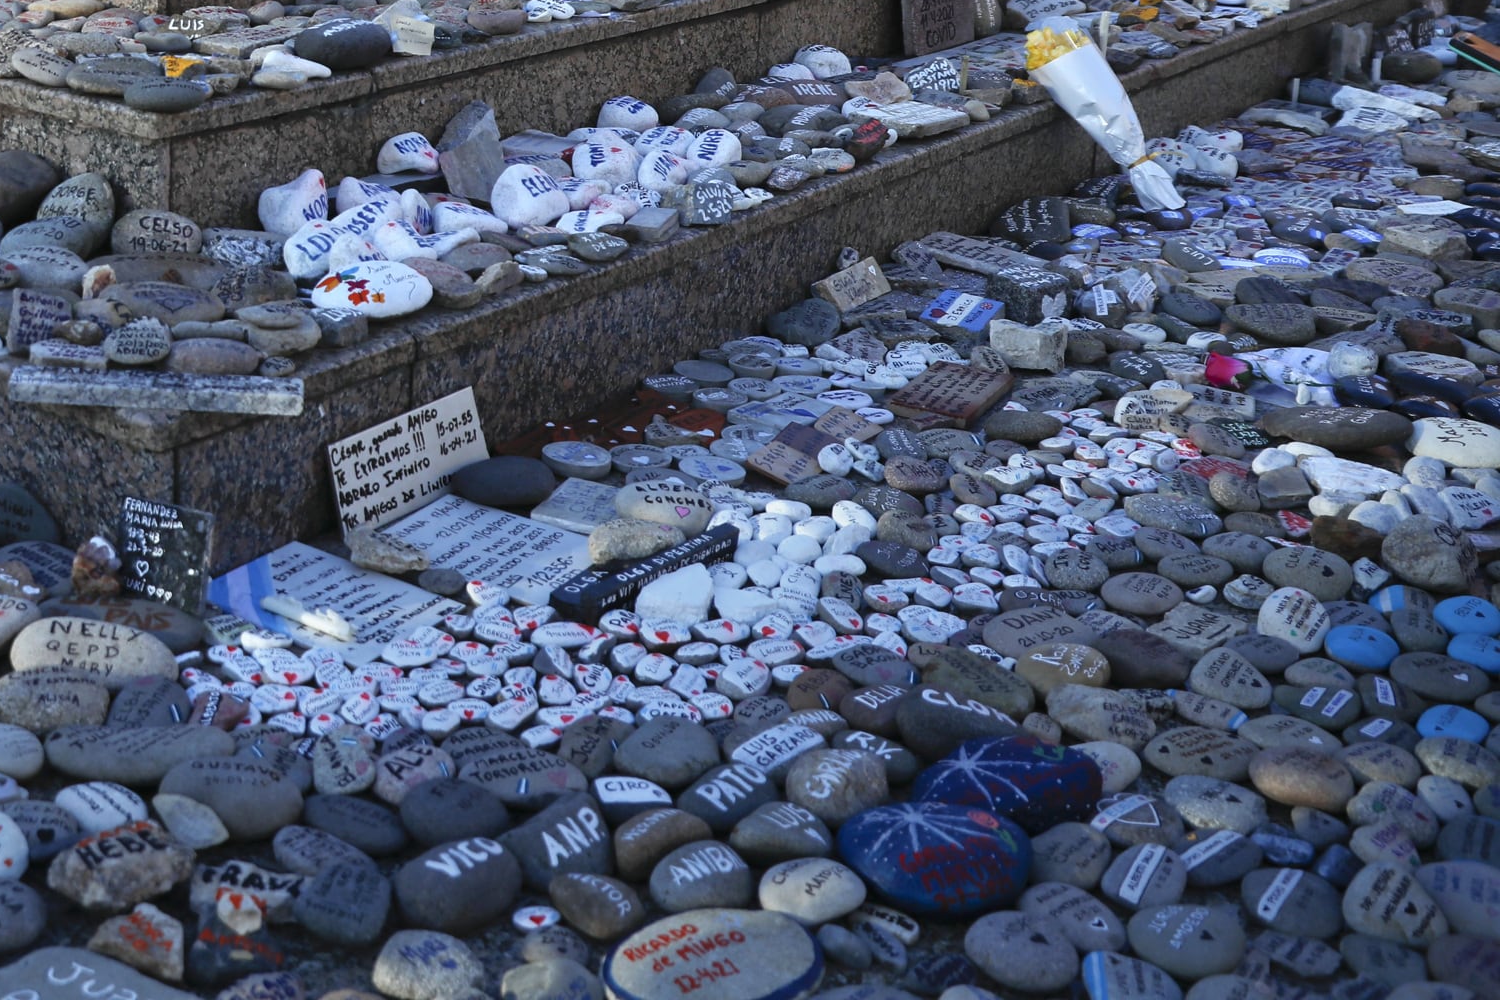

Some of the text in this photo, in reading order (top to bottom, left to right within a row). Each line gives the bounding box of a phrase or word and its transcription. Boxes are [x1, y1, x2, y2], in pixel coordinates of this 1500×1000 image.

[169, 18, 204, 31] LUIS
[926, 21, 956, 48] COVID
[792, 83, 837, 96] IRENE
[698, 129, 724, 161] NORA
[52, 187, 95, 199] JORGE
[696, 185, 732, 201] SILVIA
[139, 216, 193, 237] CELSO
[130, 237, 188, 251] 19-06-21
[1265, 256, 1302, 265] POCHA
[436, 409, 473, 438] 15-07-55
[335, 468, 347, 489] TE
[339, 481, 380, 508] ABRAZO
[402, 489, 416, 504] DE
[124, 497, 178, 519] FERNANDEZ
[125, 512, 157, 527] MARIA
[564, 571, 608, 593] OLGA
[616, 564, 653, 582] OLGA
[619, 583, 635, 598] VIP
[50, 620, 143, 642] NELLY
[1162, 613, 1220, 641] JUANA
[46, 640, 120, 657] QEPD
[855, 685, 907, 709] DELIA
[741, 734, 778, 755] LUIS
[384, 746, 433, 781] ALE
[473, 749, 548, 768] MARCELO
[469, 757, 567, 784] TORTORELLO
[605, 780, 648, 793] CIRO
[696, 764, 767, 812] PATO
[771, 802, 815, 829] LUIS
[75, 829, 168, 871] HEBE
[425, 836, 503, 879] VICO
[623, 923, 699, 962] RICARDO
[652, 955, 674, 973] de
